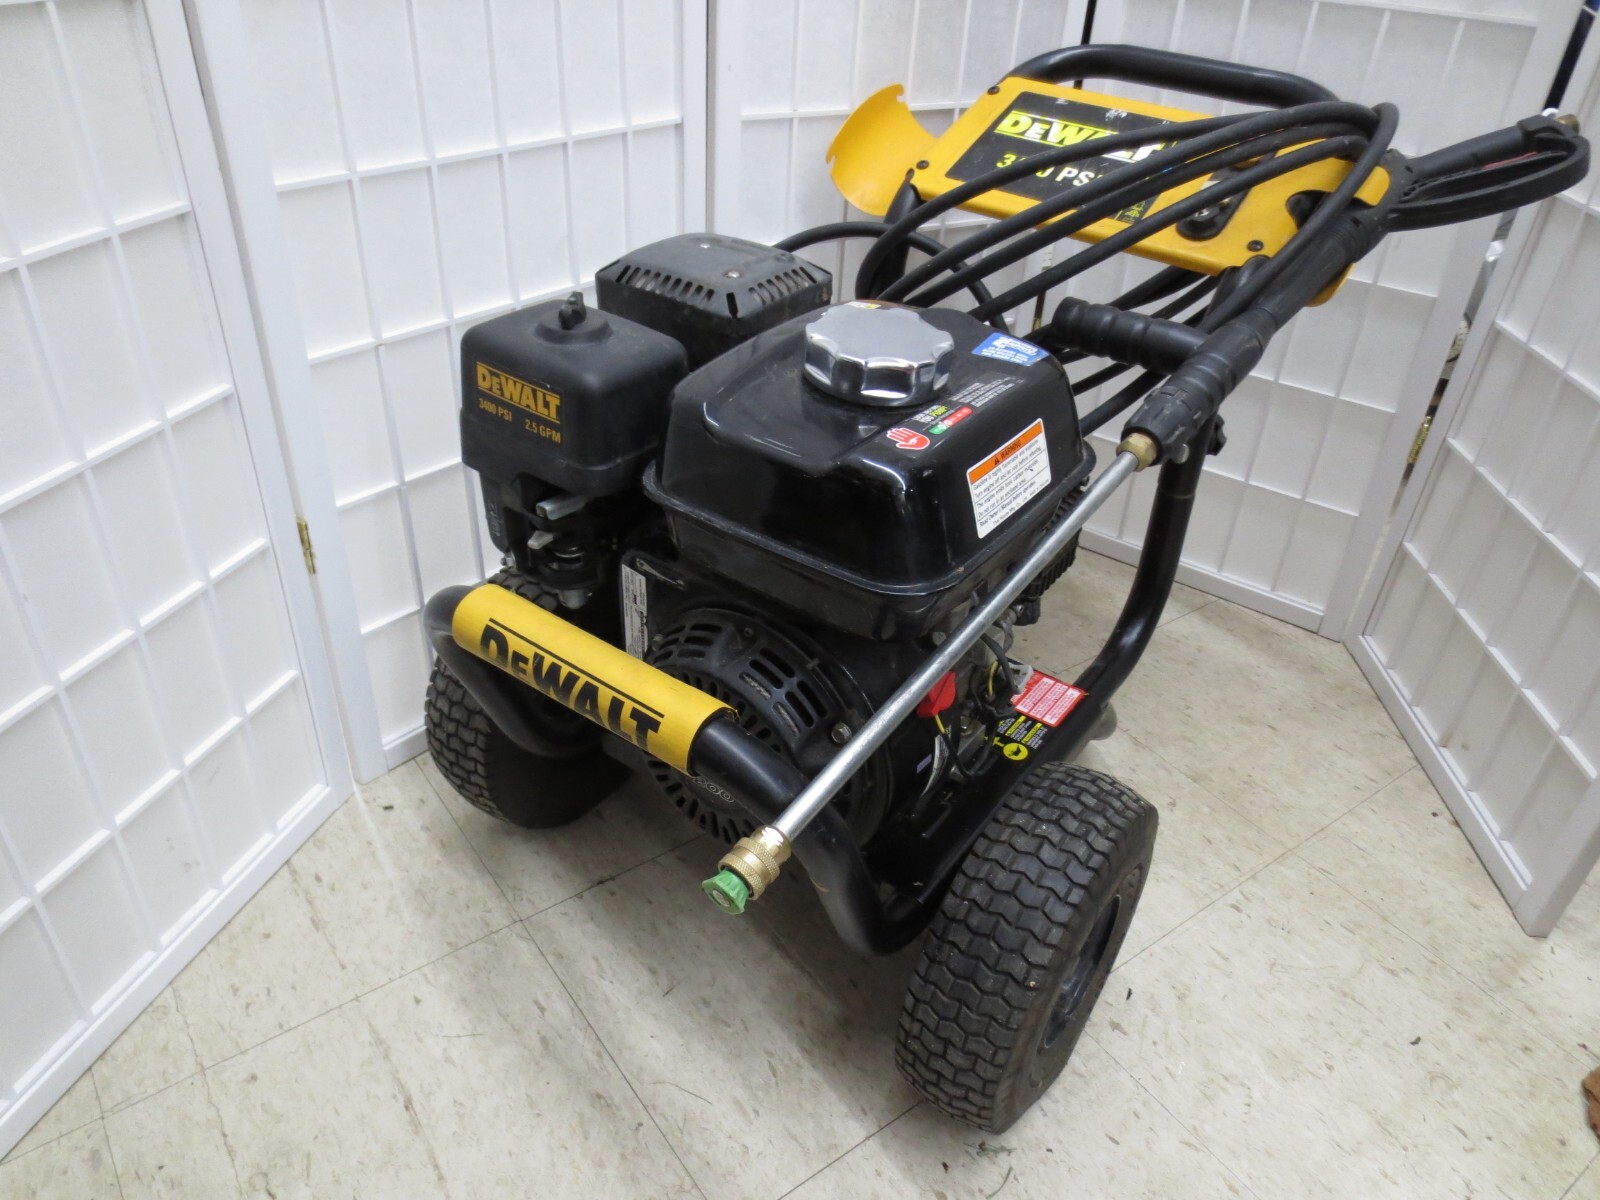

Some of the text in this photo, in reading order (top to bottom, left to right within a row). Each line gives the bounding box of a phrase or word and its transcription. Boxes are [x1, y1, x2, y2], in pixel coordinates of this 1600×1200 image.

[1055, 166, 1104, 187] PS
[476, 362, 560, 421] DEWALT
[498, 406, 513, 422] PSI
[525, 418, 538, 434] 2.5
[539, 425, 561, 444] GPM
